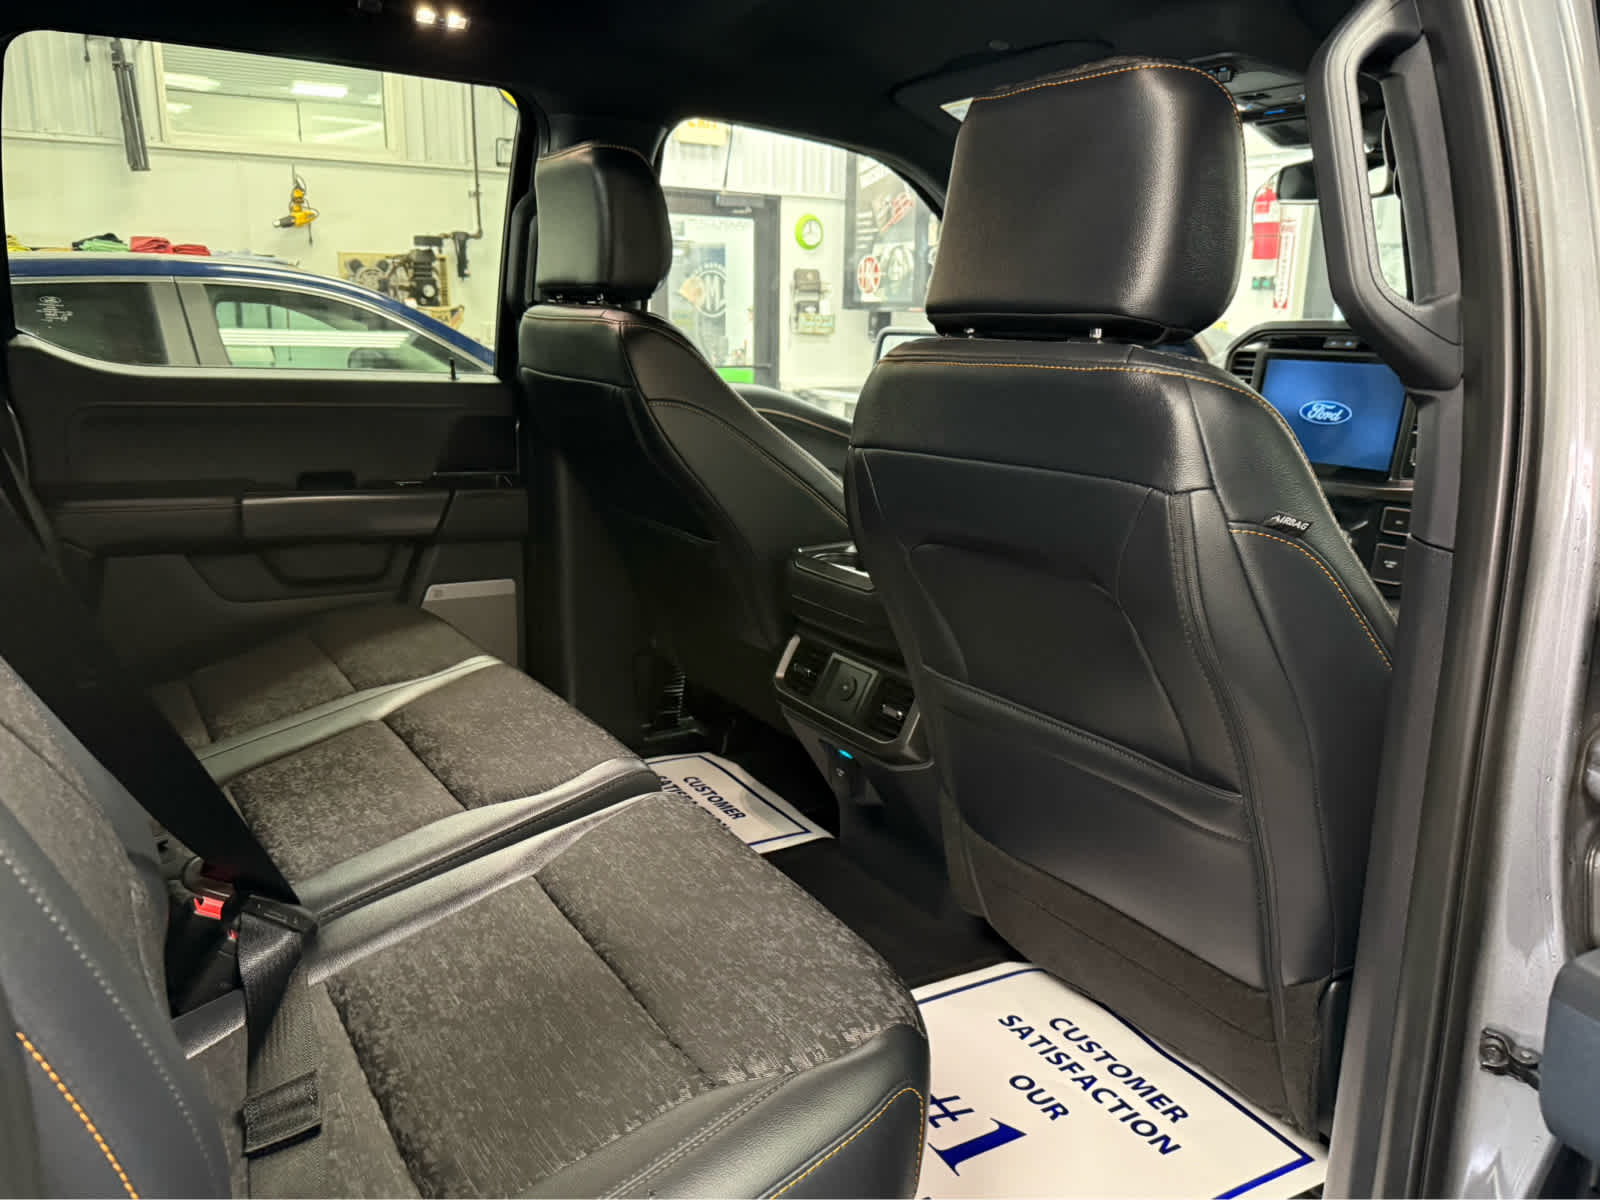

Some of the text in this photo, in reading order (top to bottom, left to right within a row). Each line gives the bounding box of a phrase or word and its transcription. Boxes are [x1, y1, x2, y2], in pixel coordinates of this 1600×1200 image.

[1307, 403, 1344, 421] Ford
[1270, 514, 1310, 531] AIRBAG
[682, 776, 746, 820] CUSTOMER
[998, 1014, 1182, 1155] SATISFACTION
[1049, 1017, 1189, 1124] CUSTOMER
[1008, 1074, 1070, 1121] OUR
[928, 1093, 1028, 1177] #1
